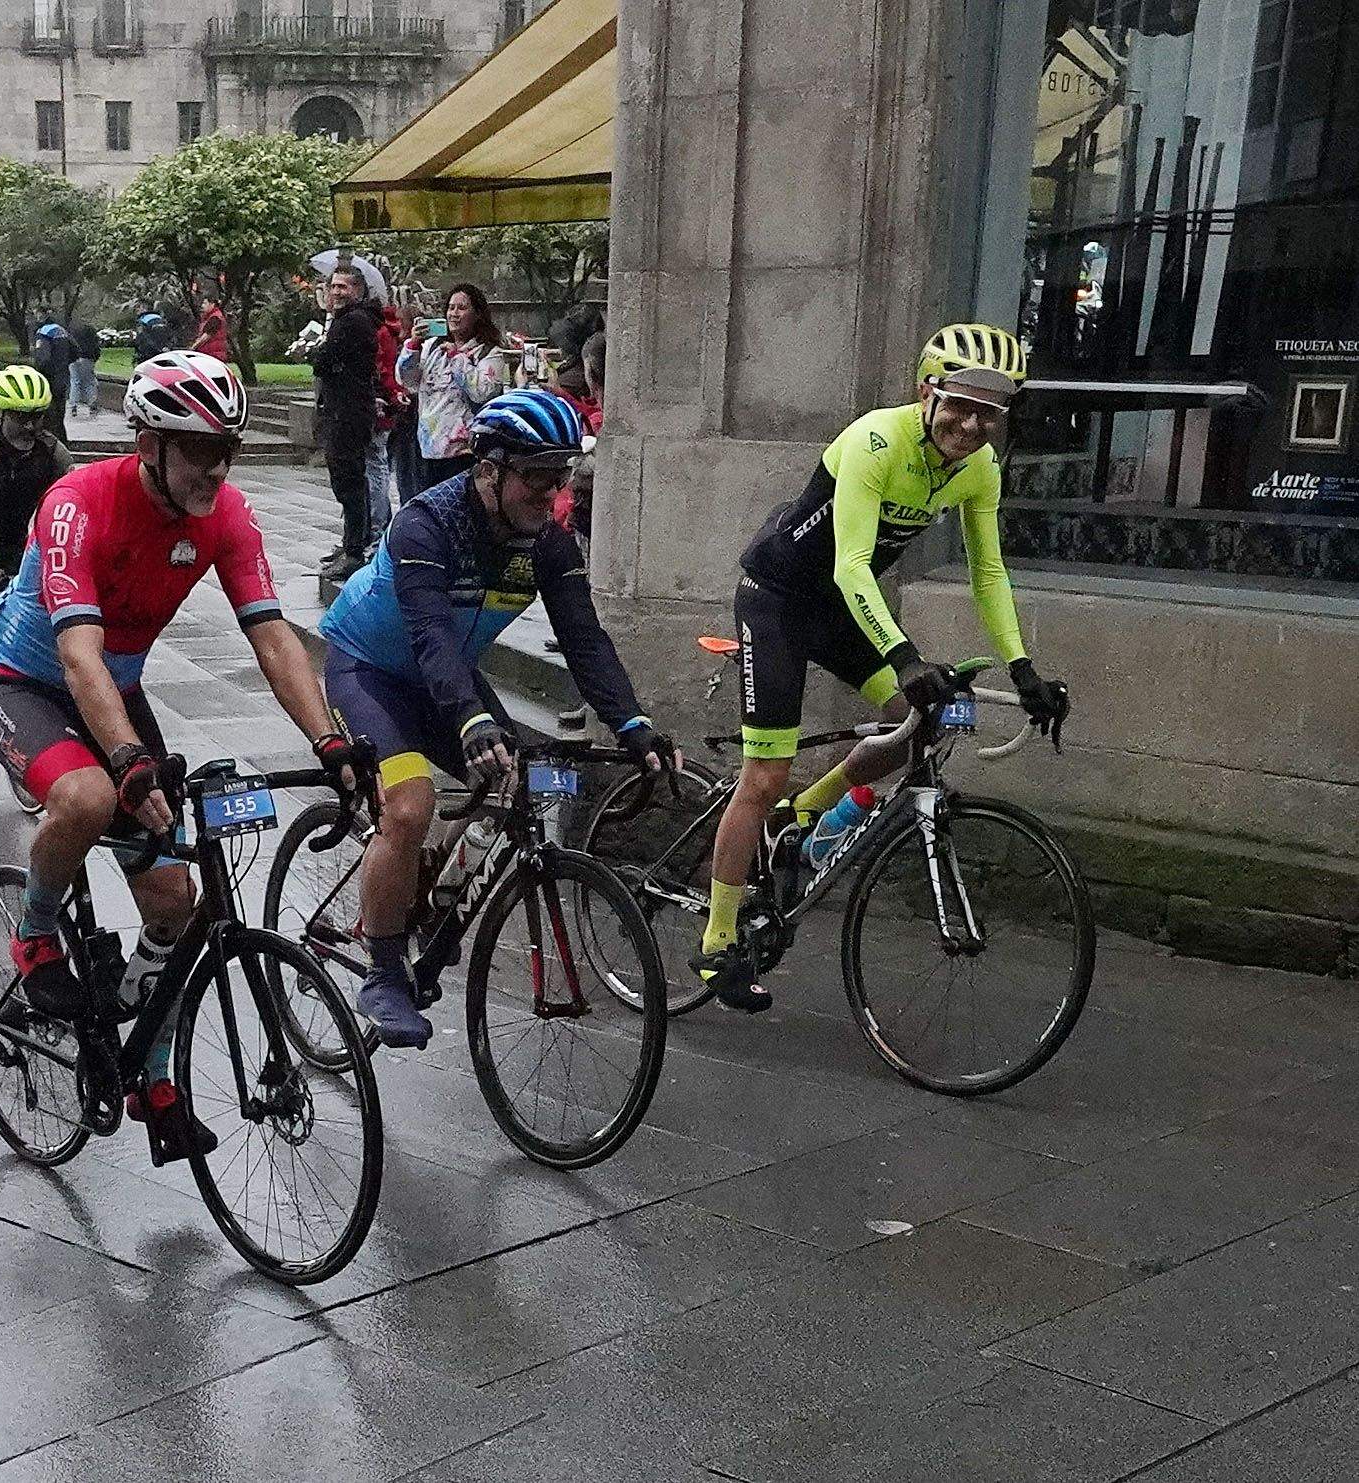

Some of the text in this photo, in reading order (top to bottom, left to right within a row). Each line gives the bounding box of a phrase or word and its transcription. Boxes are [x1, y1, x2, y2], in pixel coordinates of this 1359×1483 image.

[1275, 340, 1334, 354] ETIQUETA
[1263, 469, 1280, 487] A
[1281, 473, 1321, 489] arte
[1252, 482, 1271, 498] de
[1271, 487, 1320, 500] comer
[222, 796, 257, 817] 155
[456, 830, 513, 925] MMR
